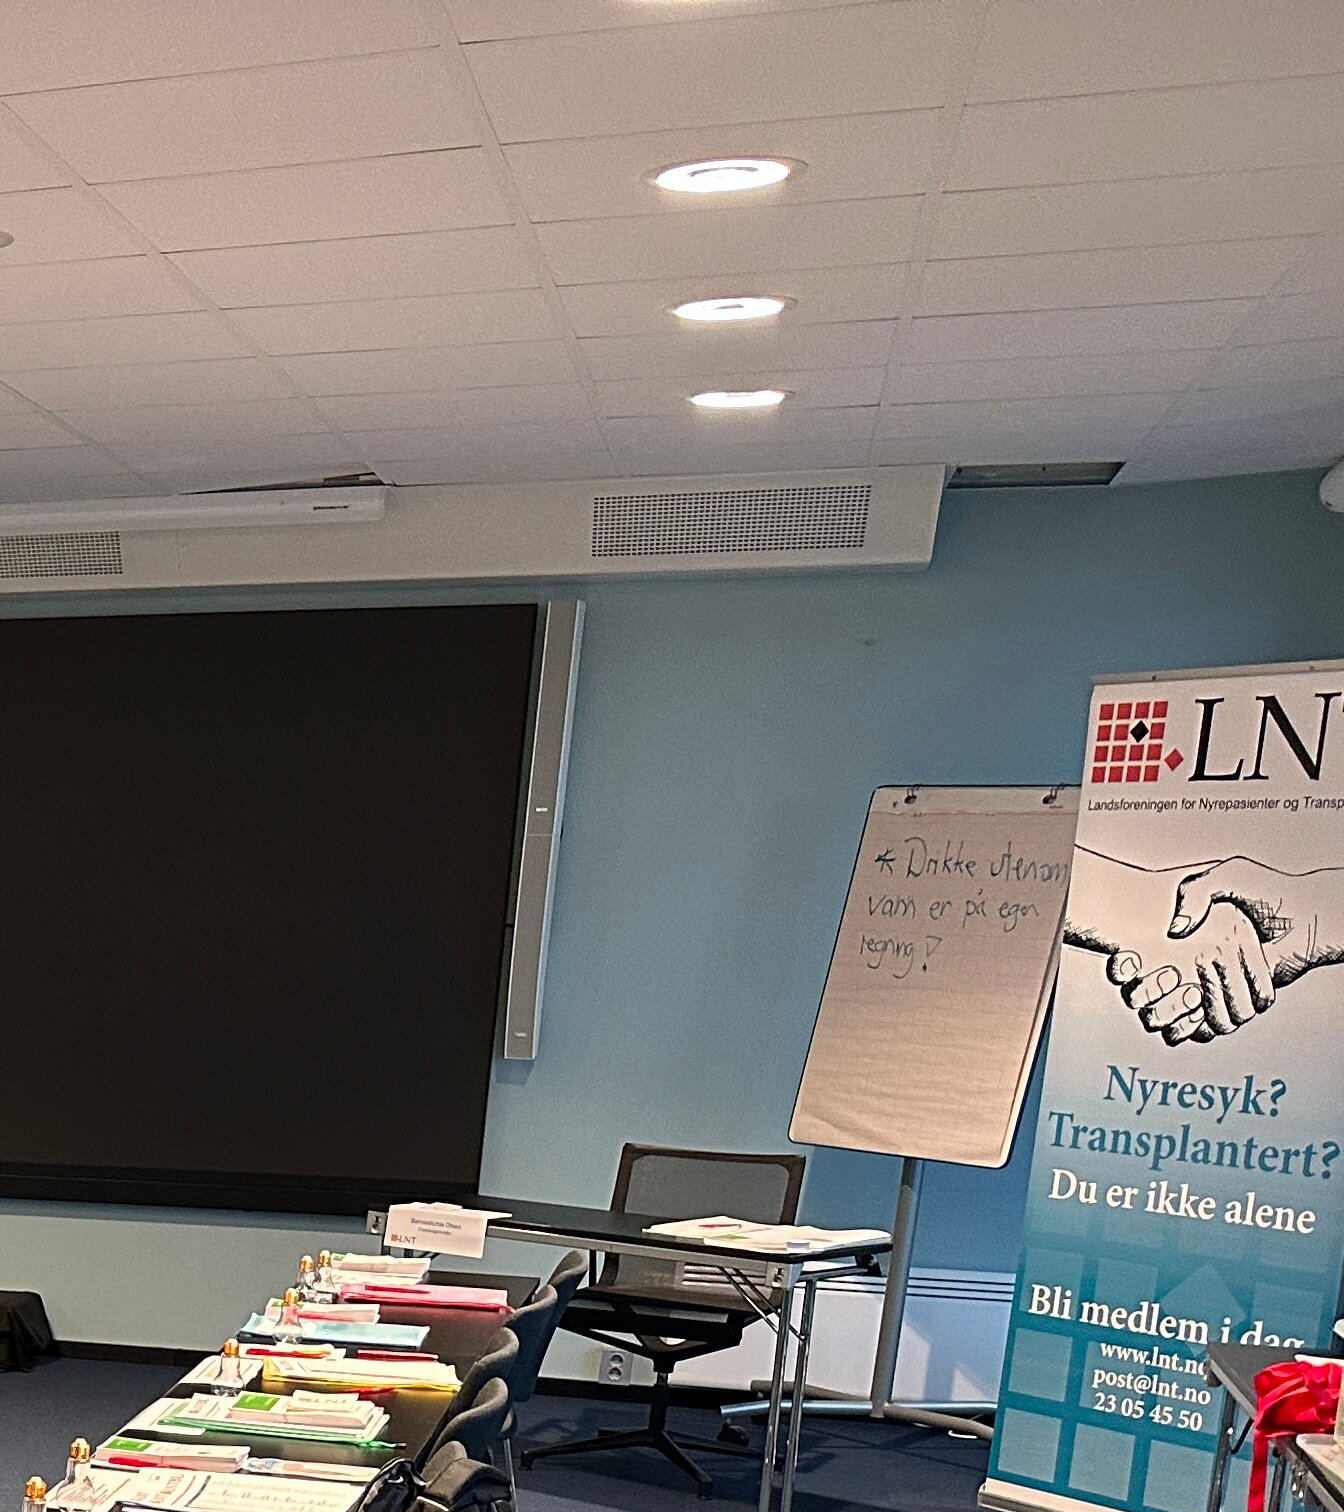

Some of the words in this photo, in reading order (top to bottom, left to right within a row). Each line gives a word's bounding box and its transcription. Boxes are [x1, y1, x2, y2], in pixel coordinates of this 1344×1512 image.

[1188, 692, 1344, 781] LN
[1088, 798, 1177, 811] Landsforeningen
[1181, 798, 1195, 810] for
[1199, 798, 1279, 812] Nyrepasienter
[1284, 800, 1299, 811] og
[904, 837, 977, 878] Drikke
[929, 902, 952, 920] er
[1102, 1065, 1287, 1123] Nyresyk?
[1047, 1111, 1340, 1180] Transplantert?
[1048, 1168, 1098, 1205] Du
[1106, 1183, 1138, 1209] er
[1144, 1181, 1215, 1219] ikke
[1223, 1192, 1316, 1233] alene
[1028, 1284, 1072, 1319] Bli
[1079, 1300, 1209, 1344] medlem
[1220, 1318, 1231, 1344] i
[1092, 1368, 1211, 1405] post@lnt.no
[1093, 1392, 1116, 1413] 23
[1120, 1398, 1144, 1420] 05
[1149, 1404, 1173, 1425] 45
[1178, 1411, 1203, 1432] 50
